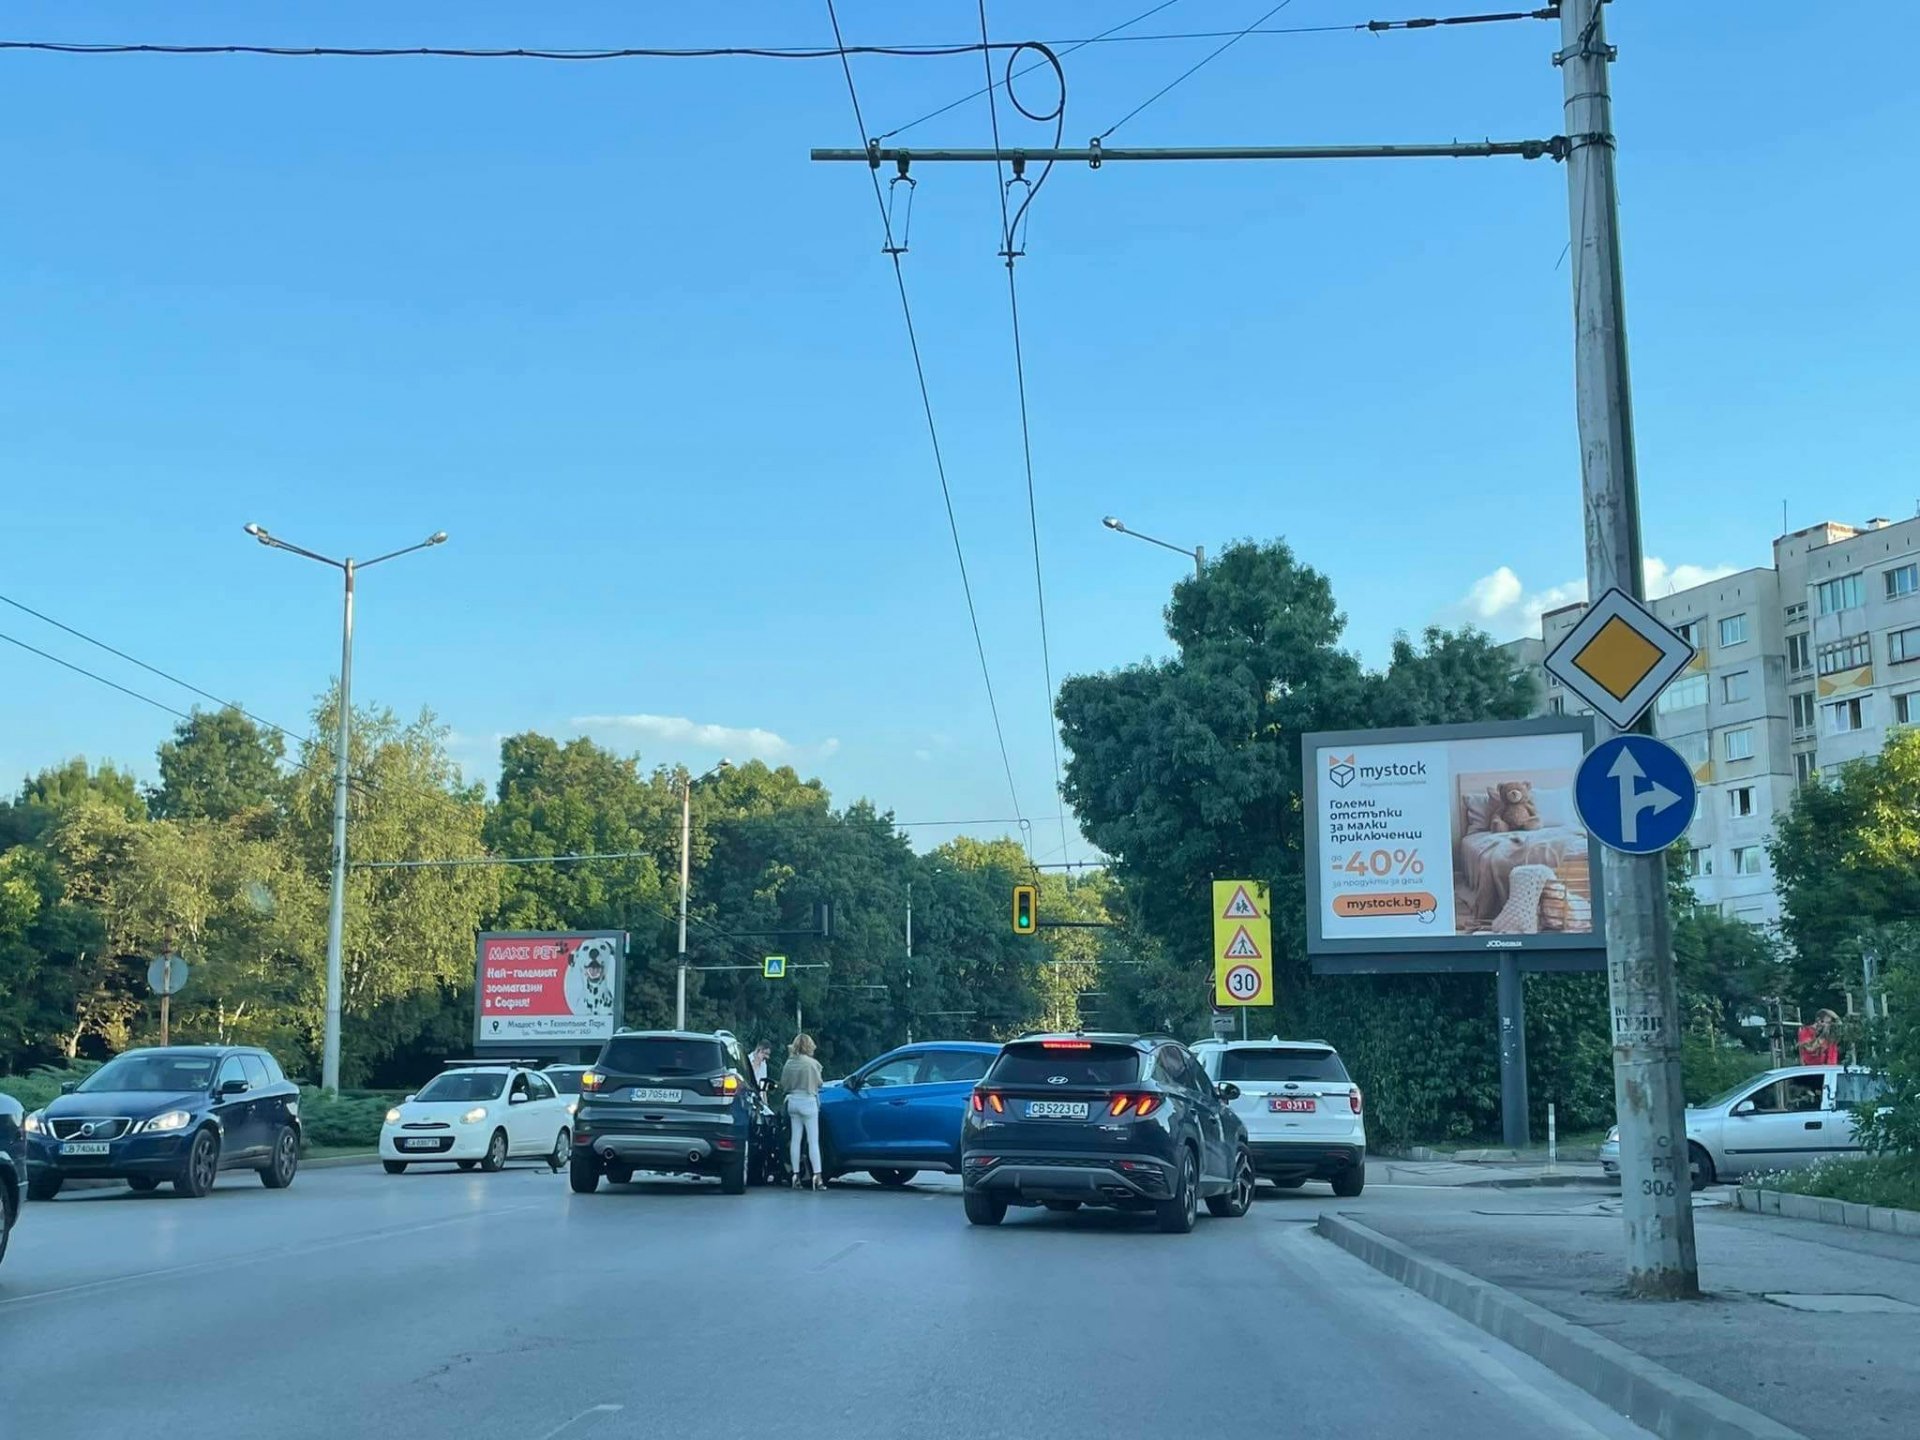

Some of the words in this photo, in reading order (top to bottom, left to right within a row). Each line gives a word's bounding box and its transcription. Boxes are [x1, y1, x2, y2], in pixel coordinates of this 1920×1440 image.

[1360, 761, 1426, 780] mystock
[1329, 799, 1375, 809] Големи
[1329, 808, 1402, 820] отстъпки
[1329, 823, 1343, 833] за
[1347, 820, 1387, 831] малки
[1331, 831, 1422, 844] приключенци
[1332, 849, 1424, 876] -40%
[1347, 897, 1421, 910] mystock.bg
[488, 946, 530, 960] MAXI
[533, 945, 560, 960] PET
[485, 984, 543, 993] зоомагазин
[1233, 973, 1254, 991] 30
[485, 999, 491, 1008] в
[1642, 1179, 1676, 1197] 306
